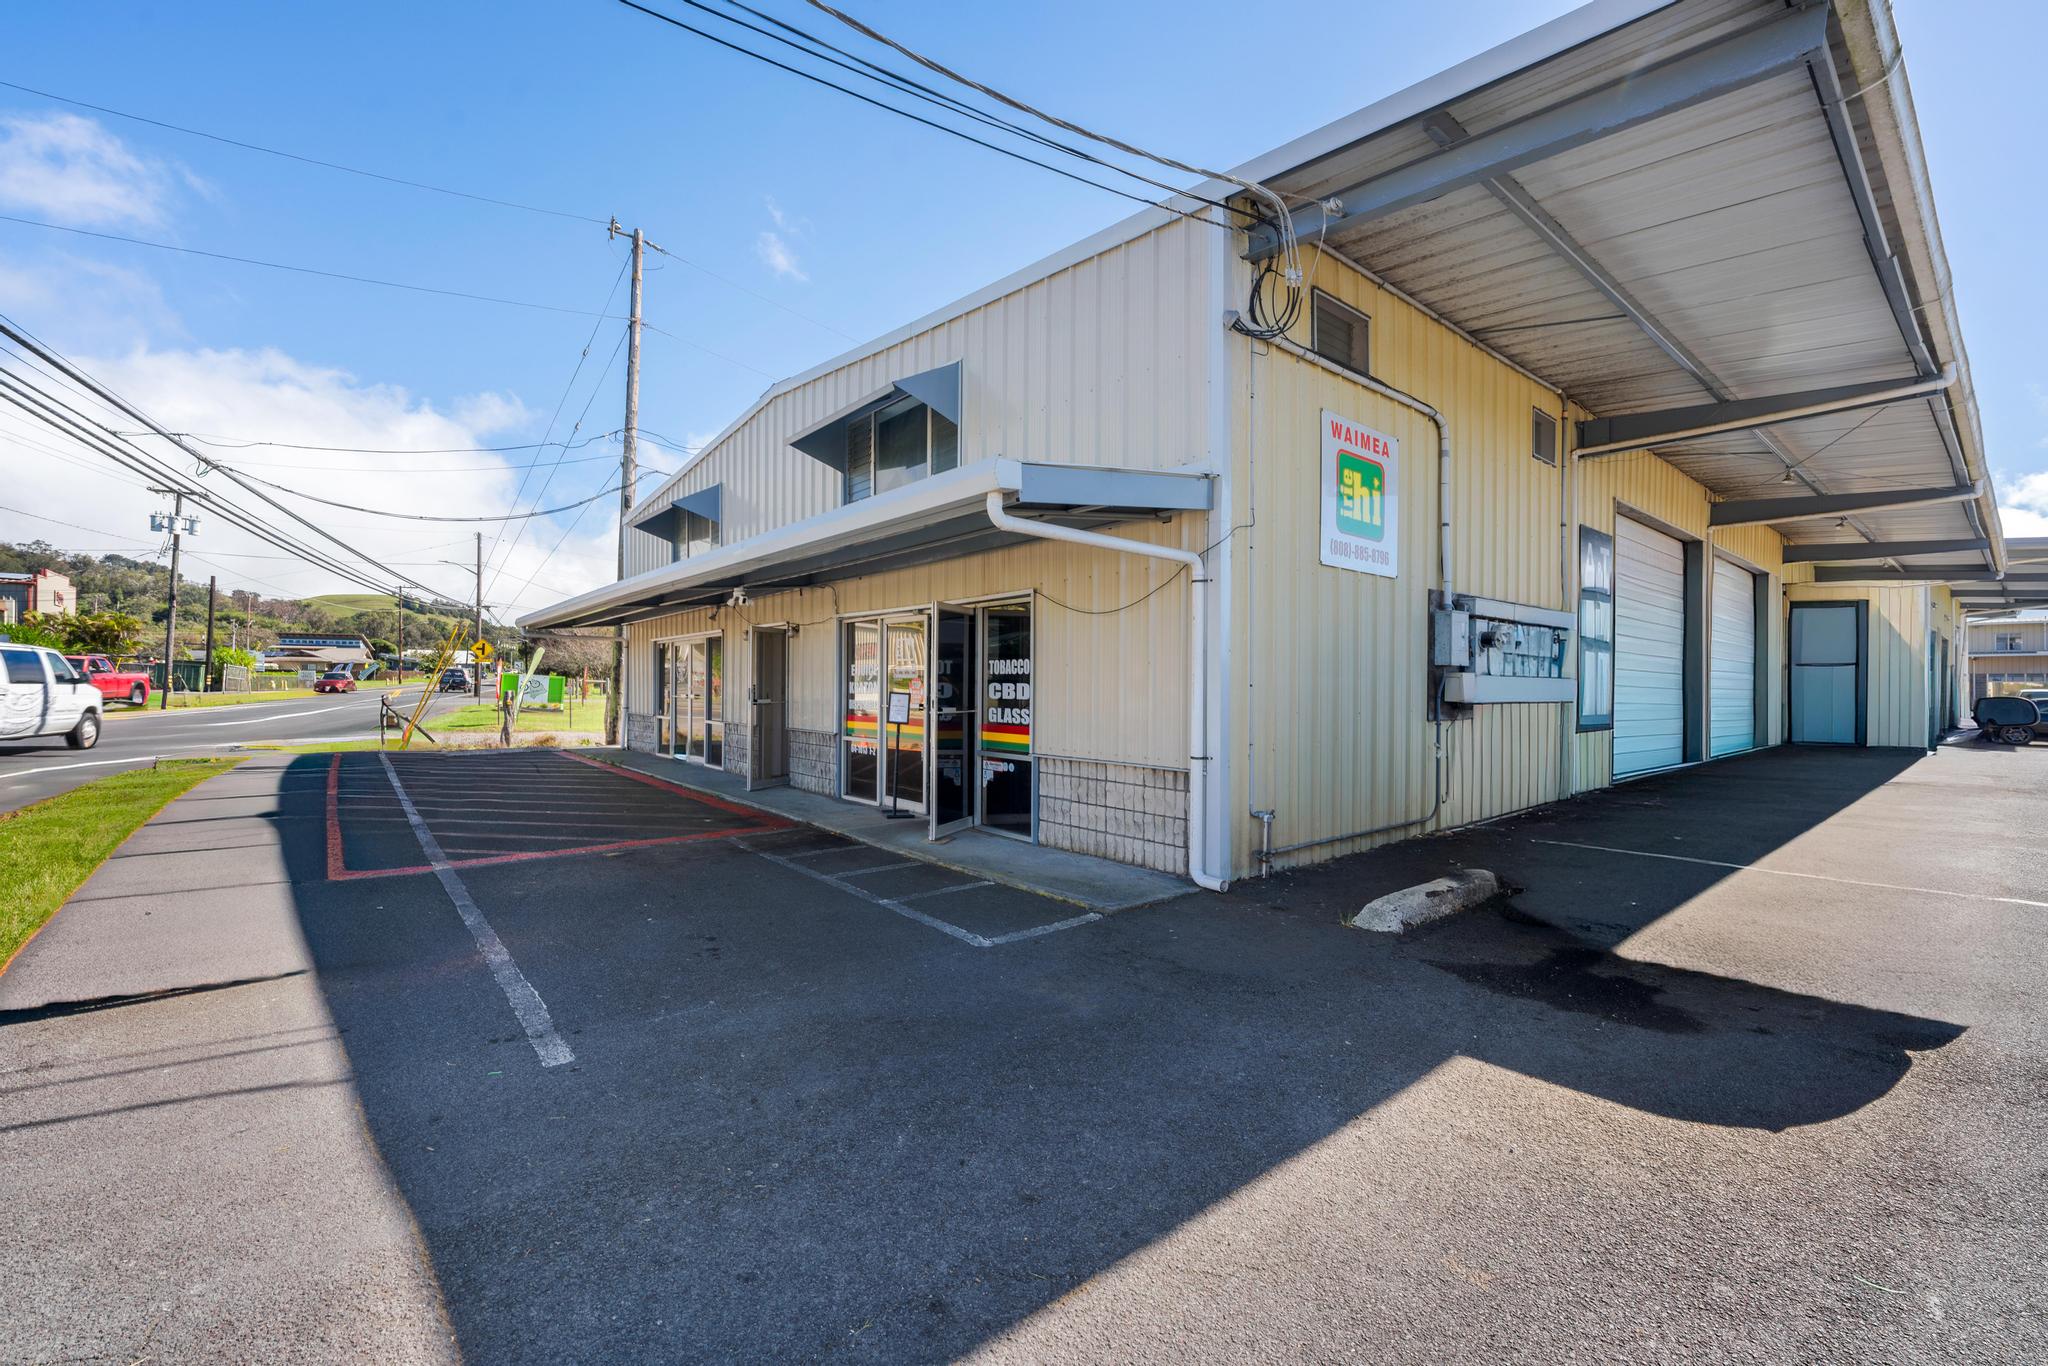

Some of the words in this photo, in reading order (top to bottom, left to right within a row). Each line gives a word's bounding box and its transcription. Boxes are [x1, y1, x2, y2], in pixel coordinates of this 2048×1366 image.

[1331, 420, 1390, 458] WAIMEA
[1352, 471, 1381, 526] hi
[988, 659, 1030, 675] TOBACCO
[988, 682, 1030, 700] CBD
[988, 707, 1030, 725] GLASS
